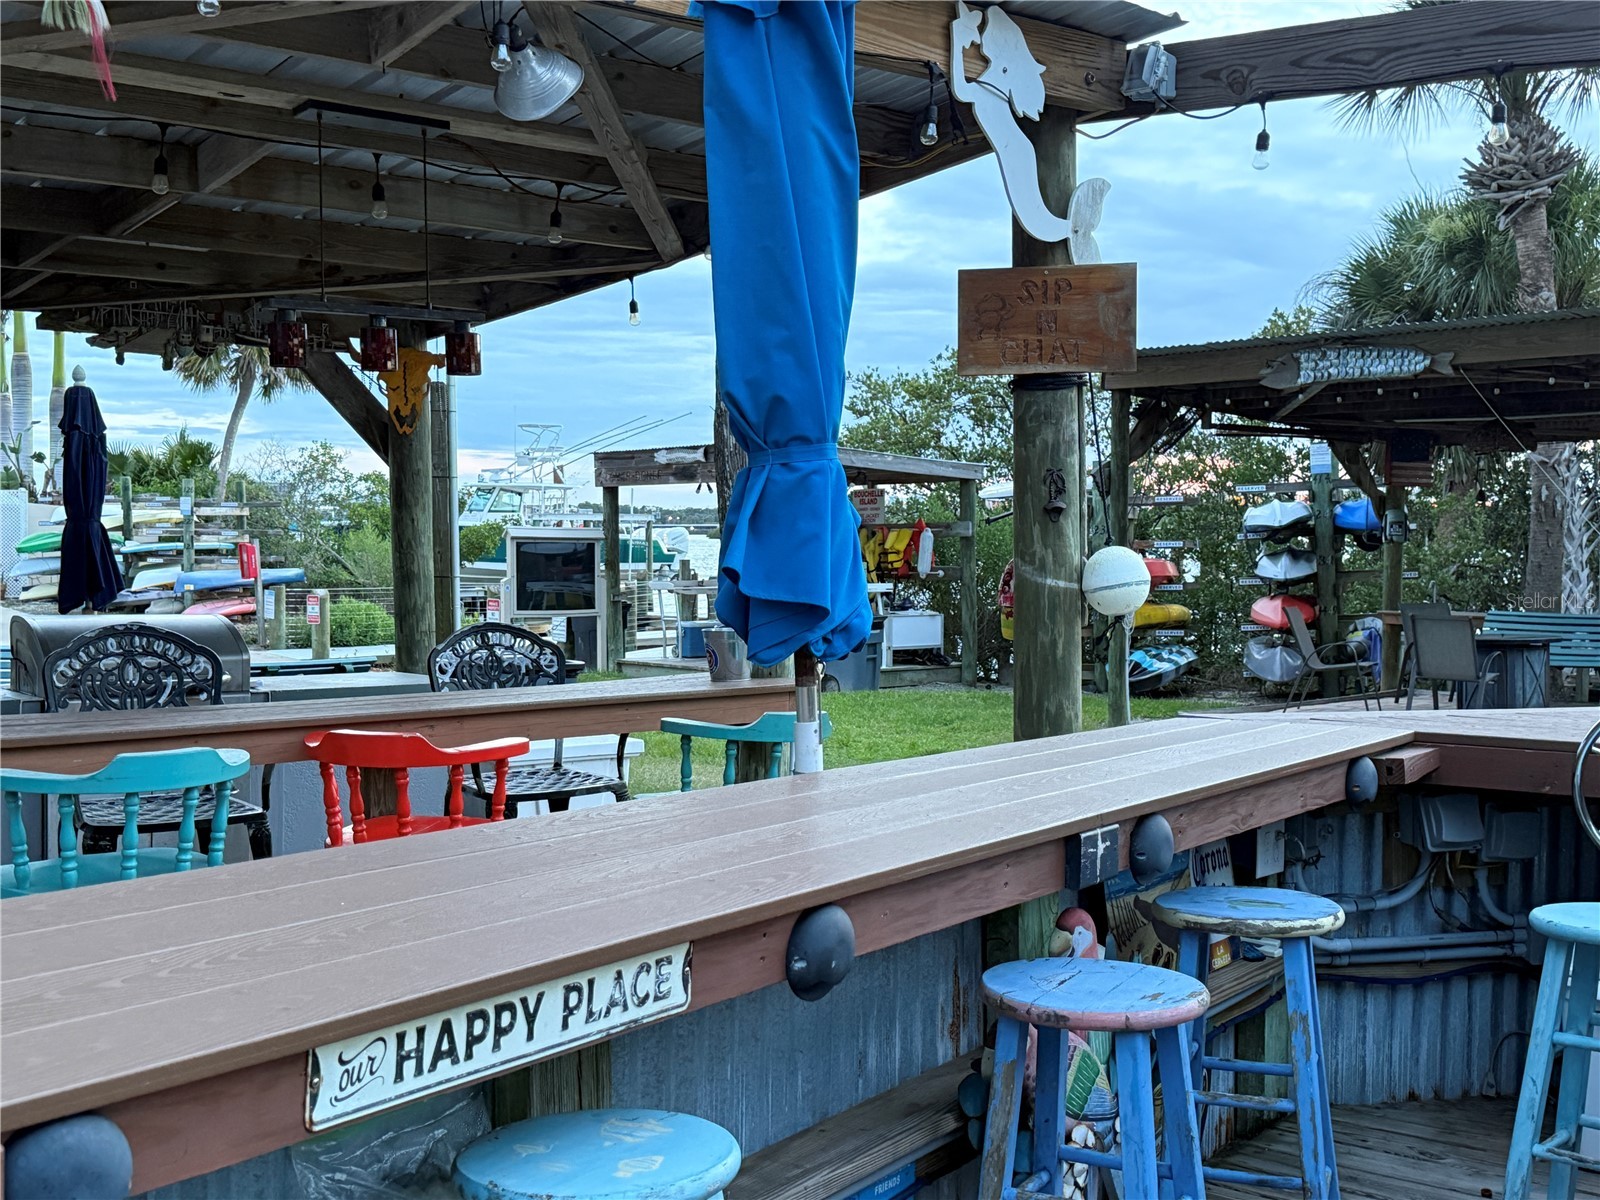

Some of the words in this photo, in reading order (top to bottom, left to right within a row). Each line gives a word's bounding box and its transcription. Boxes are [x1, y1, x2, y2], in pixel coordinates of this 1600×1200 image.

[1017, 278, 1072, 305] SIP
[1036, 310, 1057, 336] N
[1000, 338, 1088, 365] CHAT
[1192, 845, 1230, 887] Corona
[1216, 945, 1225, 955] LA
[337, 1040, 384, 1091] our
[393, 990, 546, 1085] HAPPY
[561, 955, 674, 1031] PLACE
[874, 1174, 901, 1197] FRIENDS
